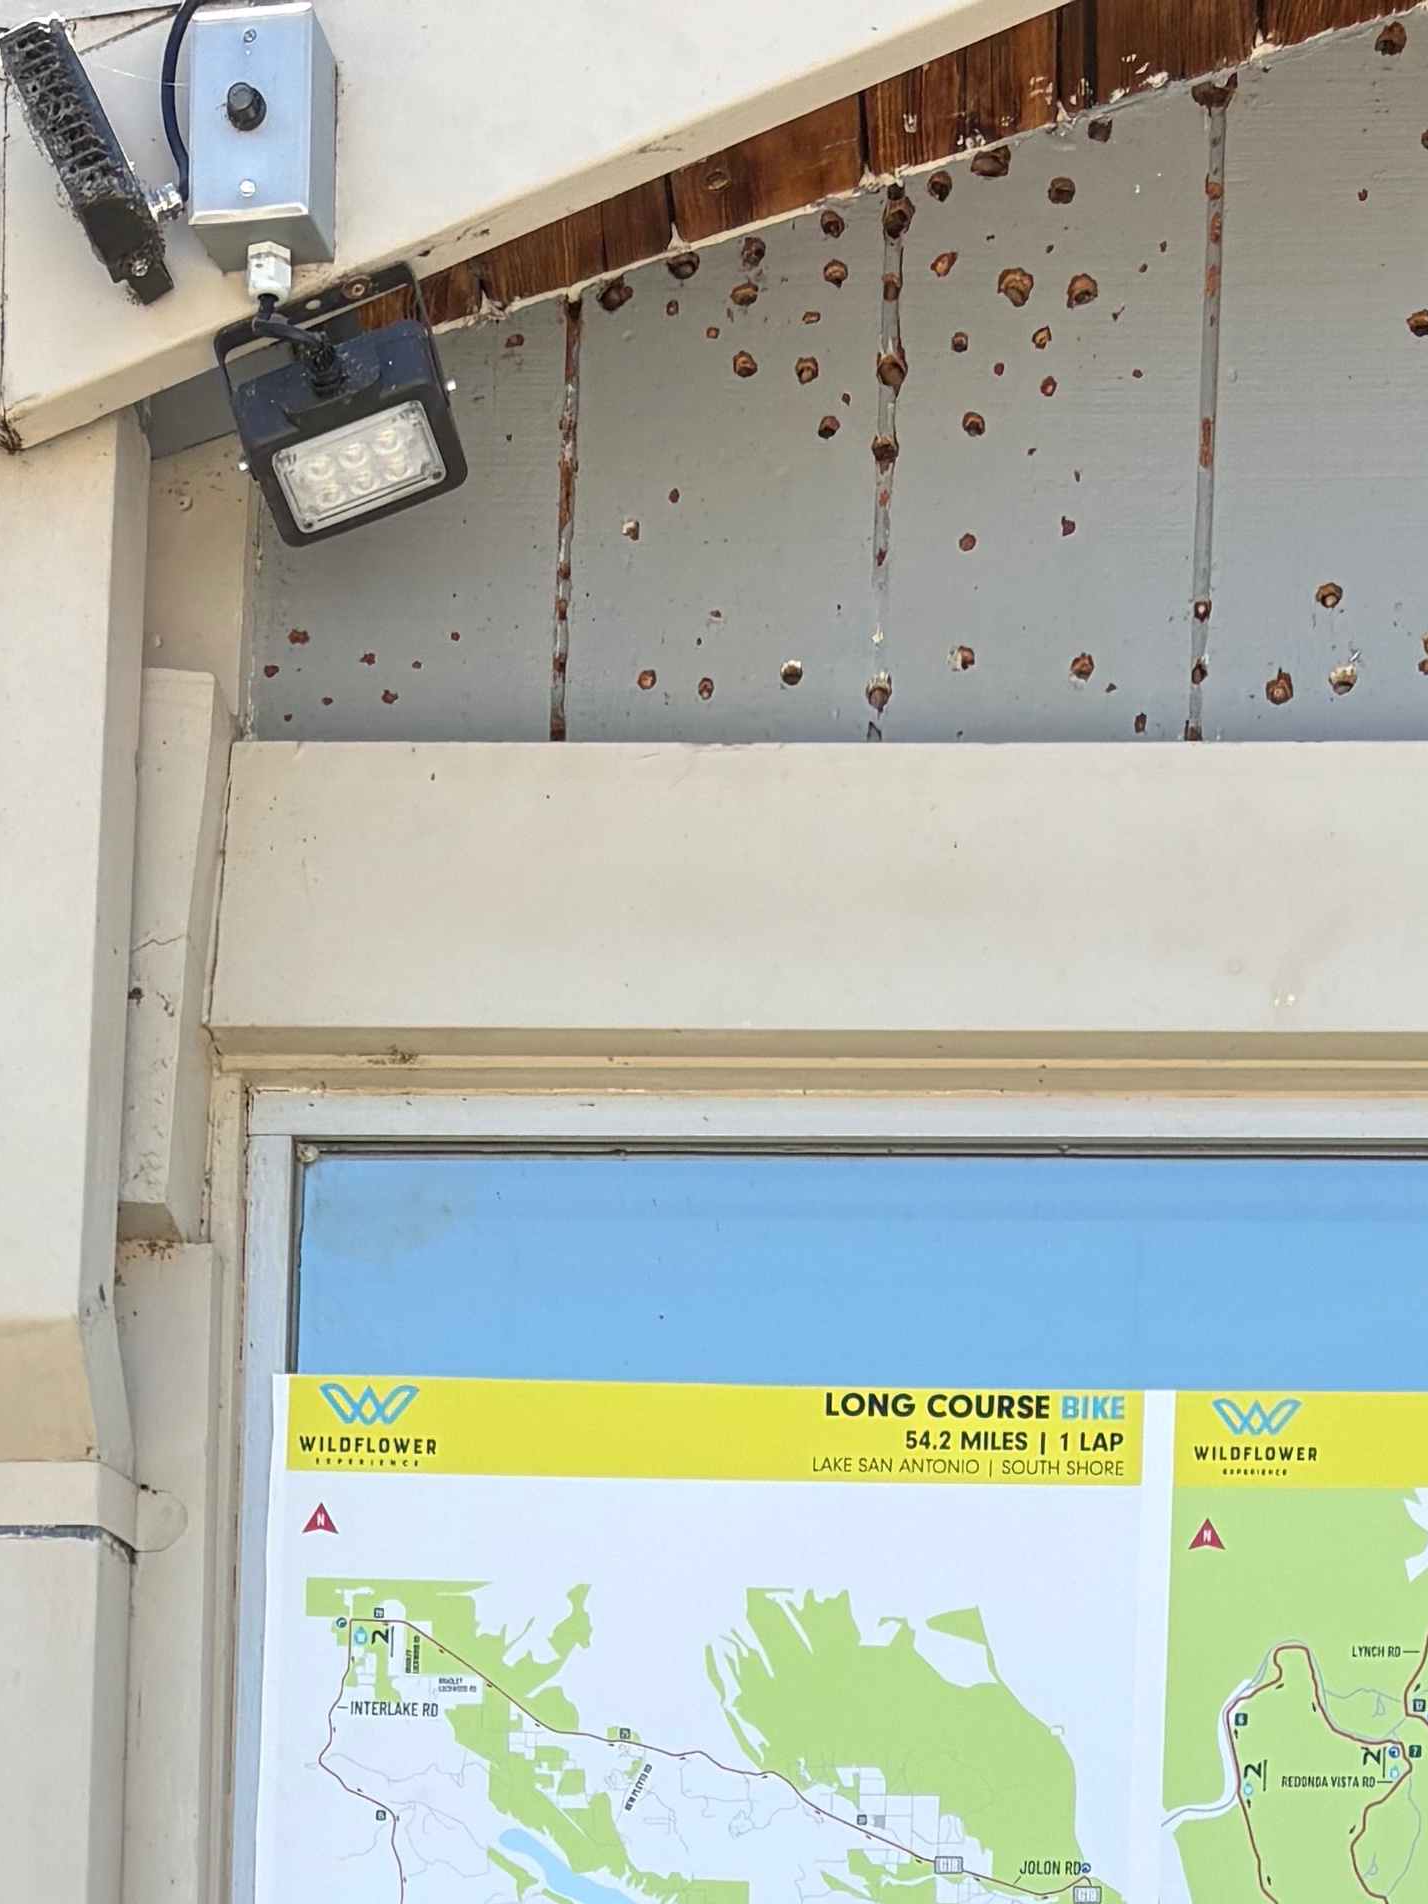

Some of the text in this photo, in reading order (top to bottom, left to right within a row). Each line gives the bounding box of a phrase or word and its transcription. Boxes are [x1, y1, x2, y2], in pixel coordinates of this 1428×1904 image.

[826, 1393, 1125, 1421] LONG COURSE BIKE
[300, 1436, 436, 1454] WILDFLOWER
[906, 1430, 1123, 1451] 54.2 MILES 1 LAP
[813, 1457, 1123, 1476] LAKE SAN ANTONIO SOUTH SHORE
[350, 1701, 439, 1717] INTERLAKE RD
